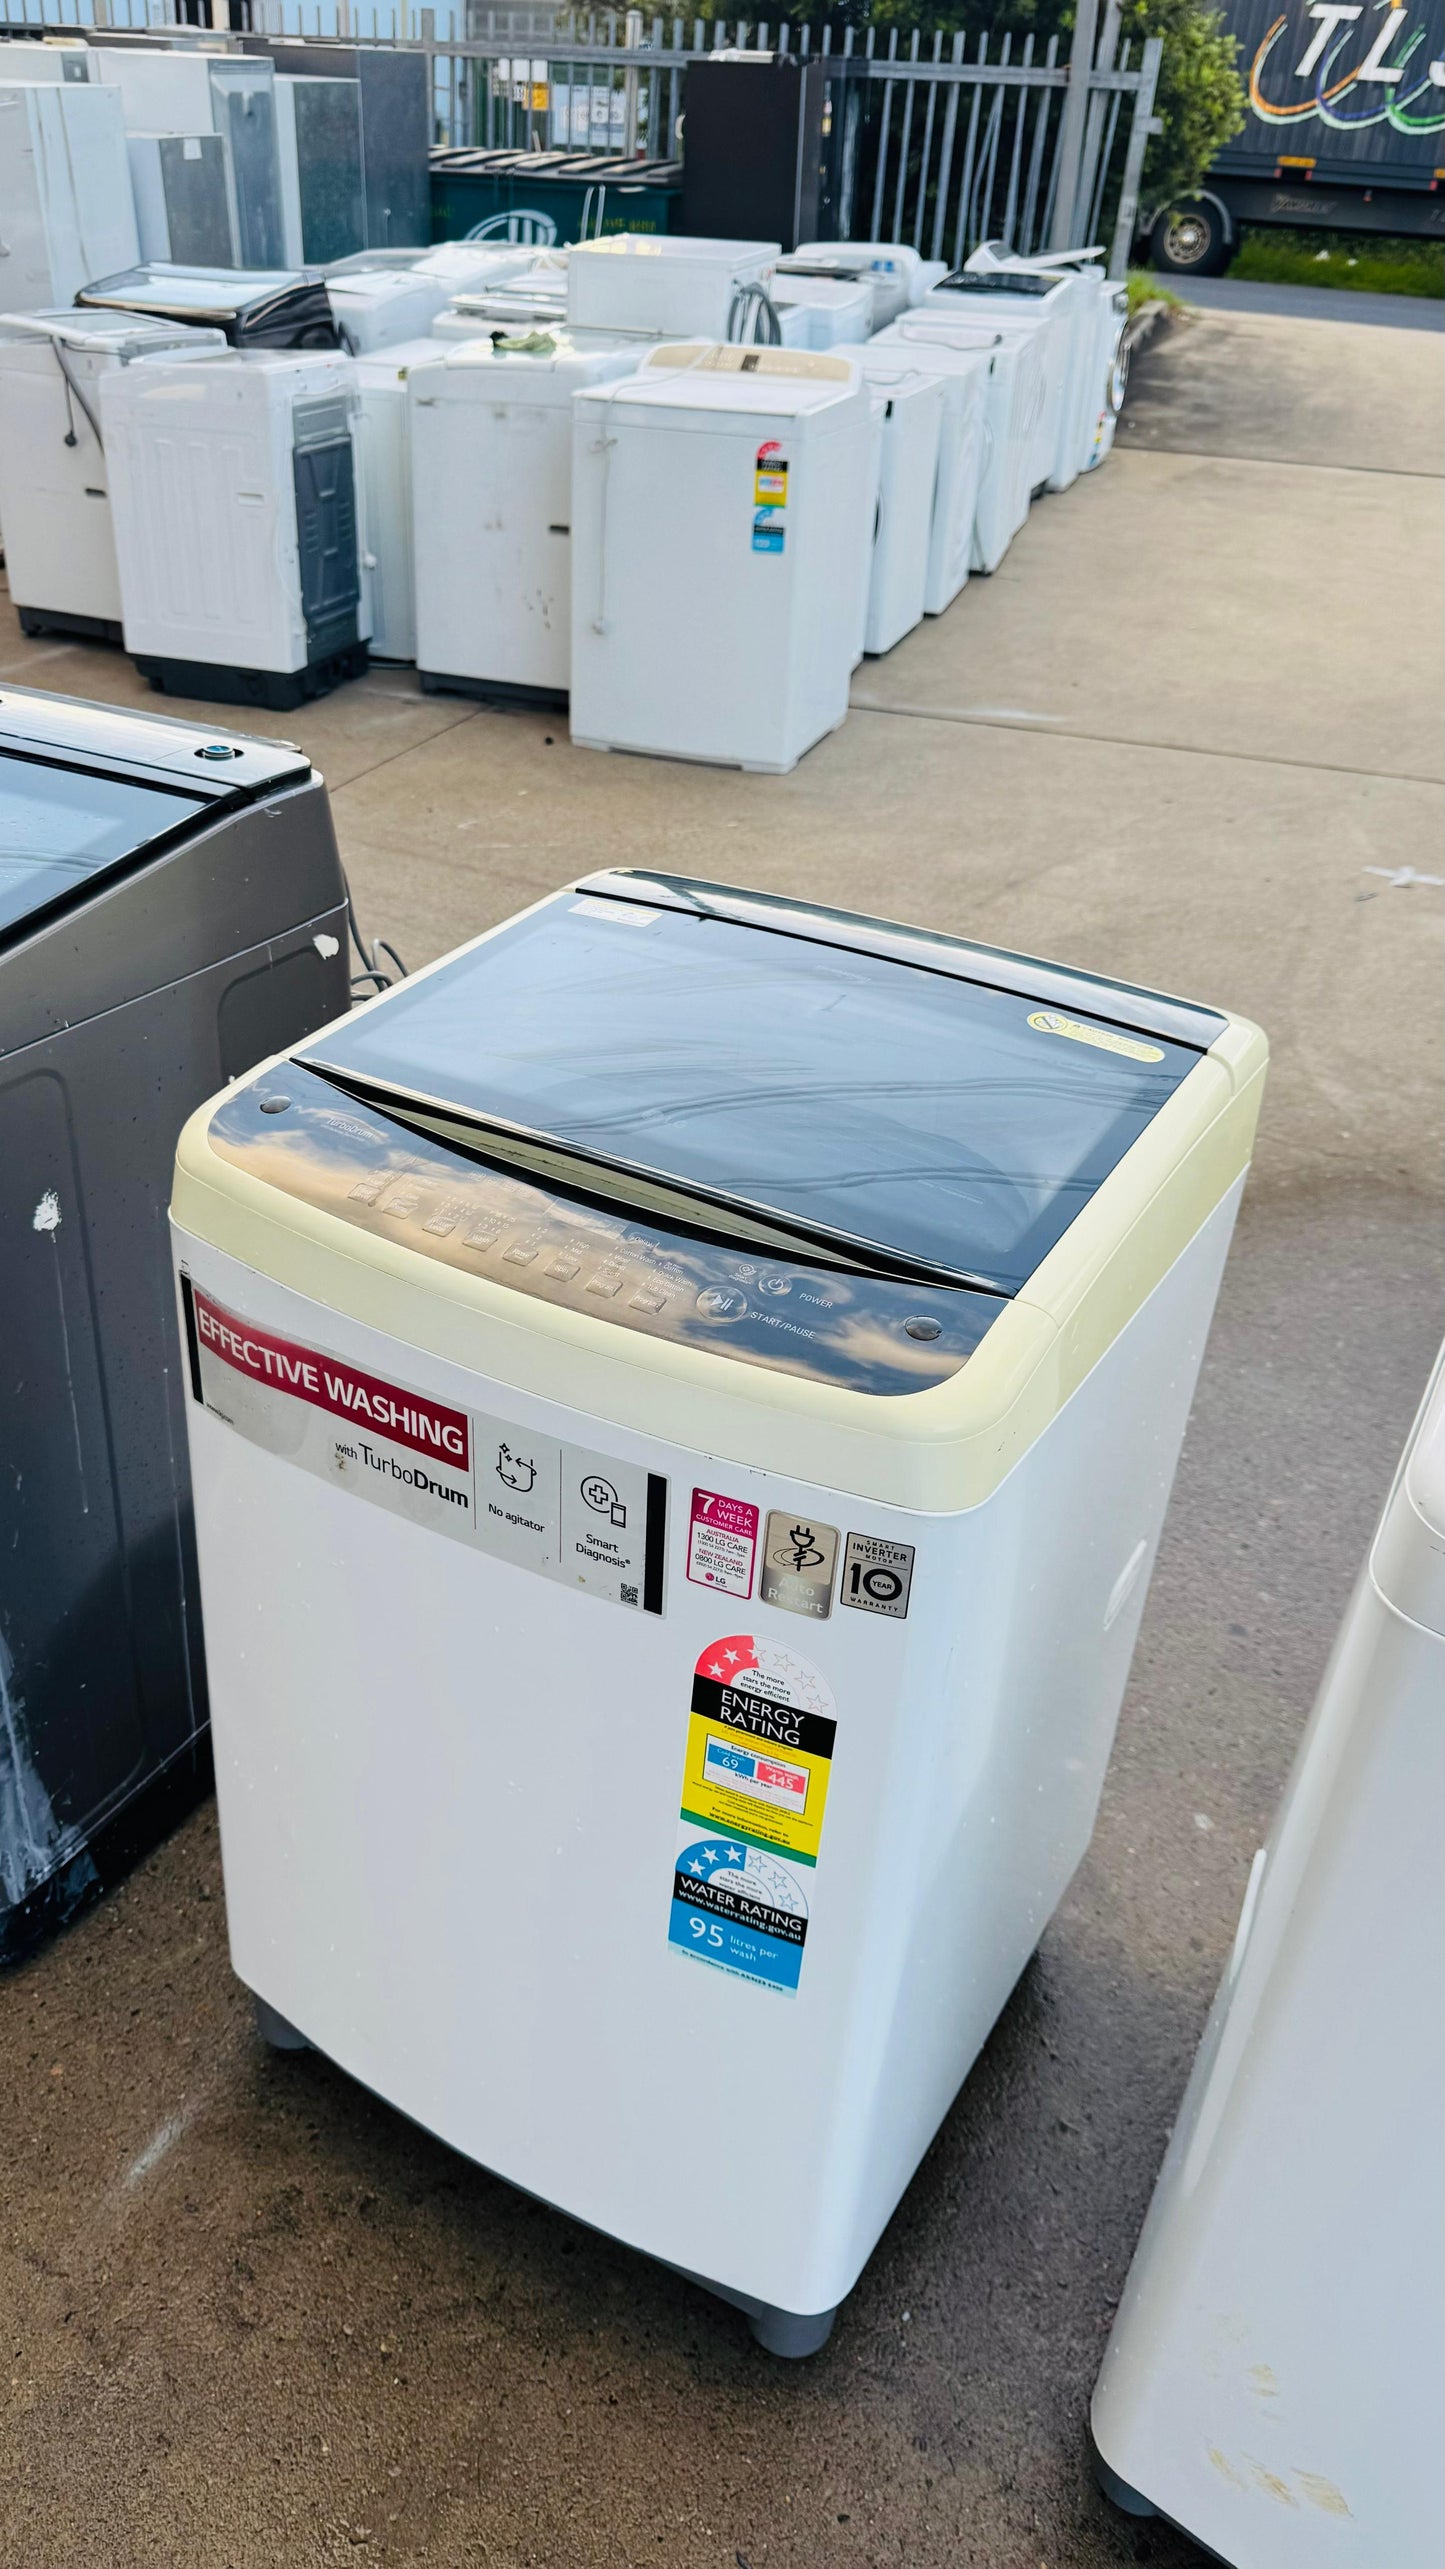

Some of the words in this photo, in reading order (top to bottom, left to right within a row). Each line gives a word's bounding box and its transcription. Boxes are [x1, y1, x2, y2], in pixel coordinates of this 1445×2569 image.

[799, 1292, 833, 1309] POWER
[750, 1311, 816, 1340] START/PAUSE
[198, 1306, 320, 1393] EFFECTIVE
[323, 1371, 464, 1456] WASHING
[335, 1441, 358, 1460] with
[358, 1443, 469, 1509] TurboDrum
[697, 1493, 715, 1514] 7
[718, 1499, 744, 1514] DAYS
[745, 1508, 753, 1517] A
[488, 1504, 506, 1519] No
[506, 1511, 546, 1534] agitator
[695, 1514, 733, 1530] CUSTOMER
[734, 1526, 753, 1536] CARE
[717, 1509, 753, 1528] WEEK
[586, 1534, 619, 1553] Smart
[697, 1532, 714, 1543] 1300
[715, 1537, 726, 1547] LG
[726, 1542, 748, 1554] CARE
[706, 1529, 740, 1544] AUSTRALIA
[866, 1540, 896, 1550] SMART
[698, 1548, 714, 1557] NEW
[714, 1552, 743, 1567] ZEALAND
[852, 1542, 908, 1562] INVERTER
[865, 1554, 894, 1565] MOTOR
[695, 1553, 713, 1564] 0800
[713, 1558, 725, 1569] LG
[725, 1563, 747, 1576] CARE
[715, 1576, 727, 1585] LG
[778, 1576, 815, 1597] Auto
[849, 1562, 904, 1602] 10
[872, 1580, 893, 1591] YEAR
[767, 1587, 824, 1614] Restart
[850, 1596, 899, 1613] WARRANTY
[743, 1677, 759, 1687] stars
[760, 1681, 771, 1690] the
[772, 1686, 791, 1696] more
[752, 1669, 765, 1680] The
[766, 1675, 785, 1686] more
[740, 1682, 763, 1695] energy
[763, 1688, 790, 1703] efficient
[721, 1689, 805, 1728] ENERGY
[719, 1706, 801, 1745] RATING
[721, 1756, 739, 1770] 69
[731, 1745, 750, 1757] Energy
[751, 1751, 786, 1769] consumption
[734, 1772, 749, 1782] kWh
[749, 1777, 759, 1786] per
[760, 1782, 773, 1790] year
[767, 1773, 795, 1789] 445
[728, 1871, 739, 1880] The
[680, 1876, 736, 1909] WATER
[740, 1902, 802, 1931] RATING
[678, 1889, 802, 1941] www.waterrating.gov.au
[689, 1917, 724, 1948] 95
[729, 1935, 757, 1952] litres
[759, 1944, 779, 1959] per
[729, 1946, 757, 1962] wash
